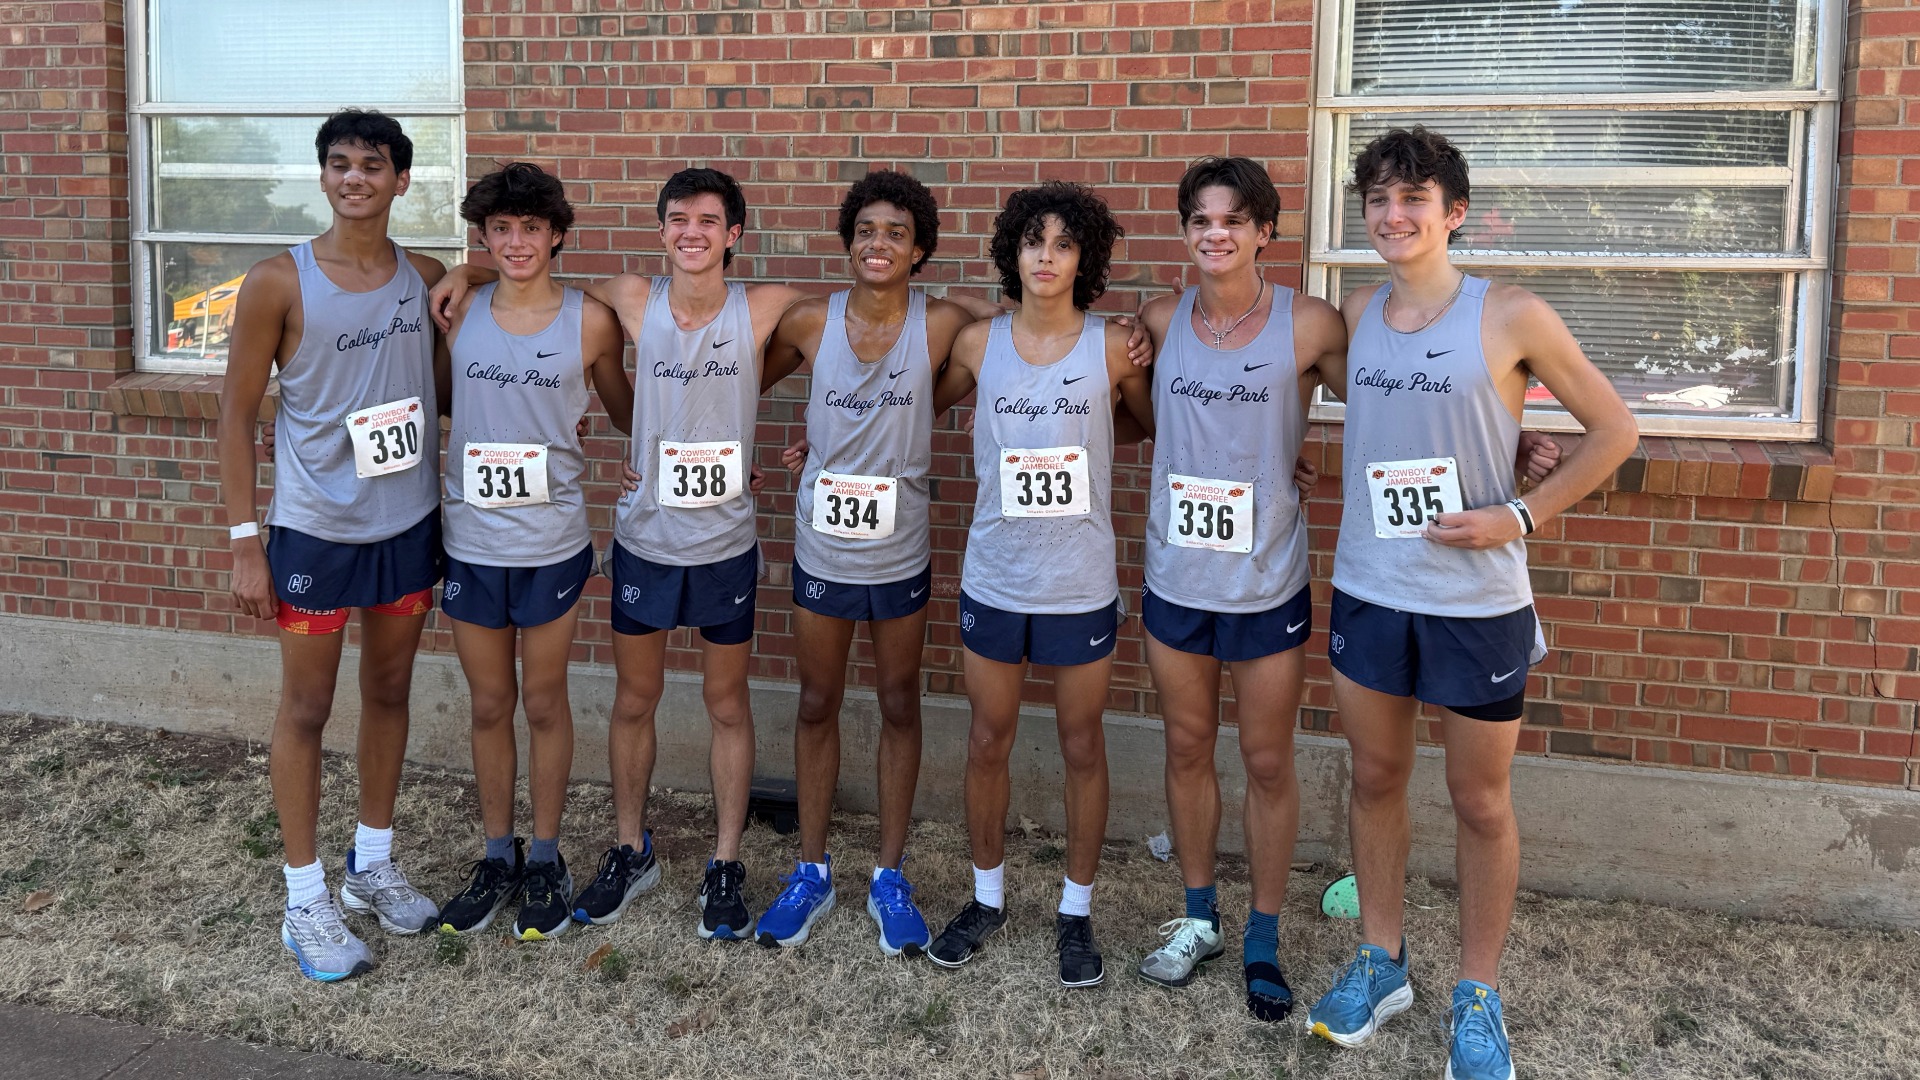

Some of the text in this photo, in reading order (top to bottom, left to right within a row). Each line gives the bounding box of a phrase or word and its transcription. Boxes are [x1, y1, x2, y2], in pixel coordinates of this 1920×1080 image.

[336, 317, 422, 351] College Park
[467, 361, 561, 388] College Park
[653, 360, 740, 387] College Park
[1355, 366, 1453, 397] College Park
[1170, 376, 1270, 406] College Park
[825, 389, 914, 417] College Park
[994, 396, 1091, 423] College Park
[371, 407, 407, 421] COWBOY
[371, 413, 411, 429] JAMBOREE
[369, 421, 418, 465] 330
[680, 449, 717, 457] COWBOY
[480, 457, 524, 465] JAMBOREE
[484, 450, 521, 458] COWBOY
[1022, 455, 1061, 463] COWBOY
[1020, 462, 1065, 470] JAMBOREE
[1387, 467, 1427, 478] COWBOY
[477, 465, 530, 498] 331
[673, 464, 726, 497] 338
[835, 481, 872, 490] COWBOY
[1015, 471, 1073, 506] 333
[1187, 484, 1225, 495] COWBOY
[1385, 476, 1433, 486] JAMBOREE
[831, 487, 875, 498] JAMBOREE
[1183, 491, 1229, 503] JAMBOREE
[826, 494, 879, 530] 334
[1383, 485, 1444, 526] 335
[1178, 499, 1234, 541] 336
[287, 573, 313, 594] CP
[805, 580, 826, 599] CP
[621, 584, 640, 604] CP
